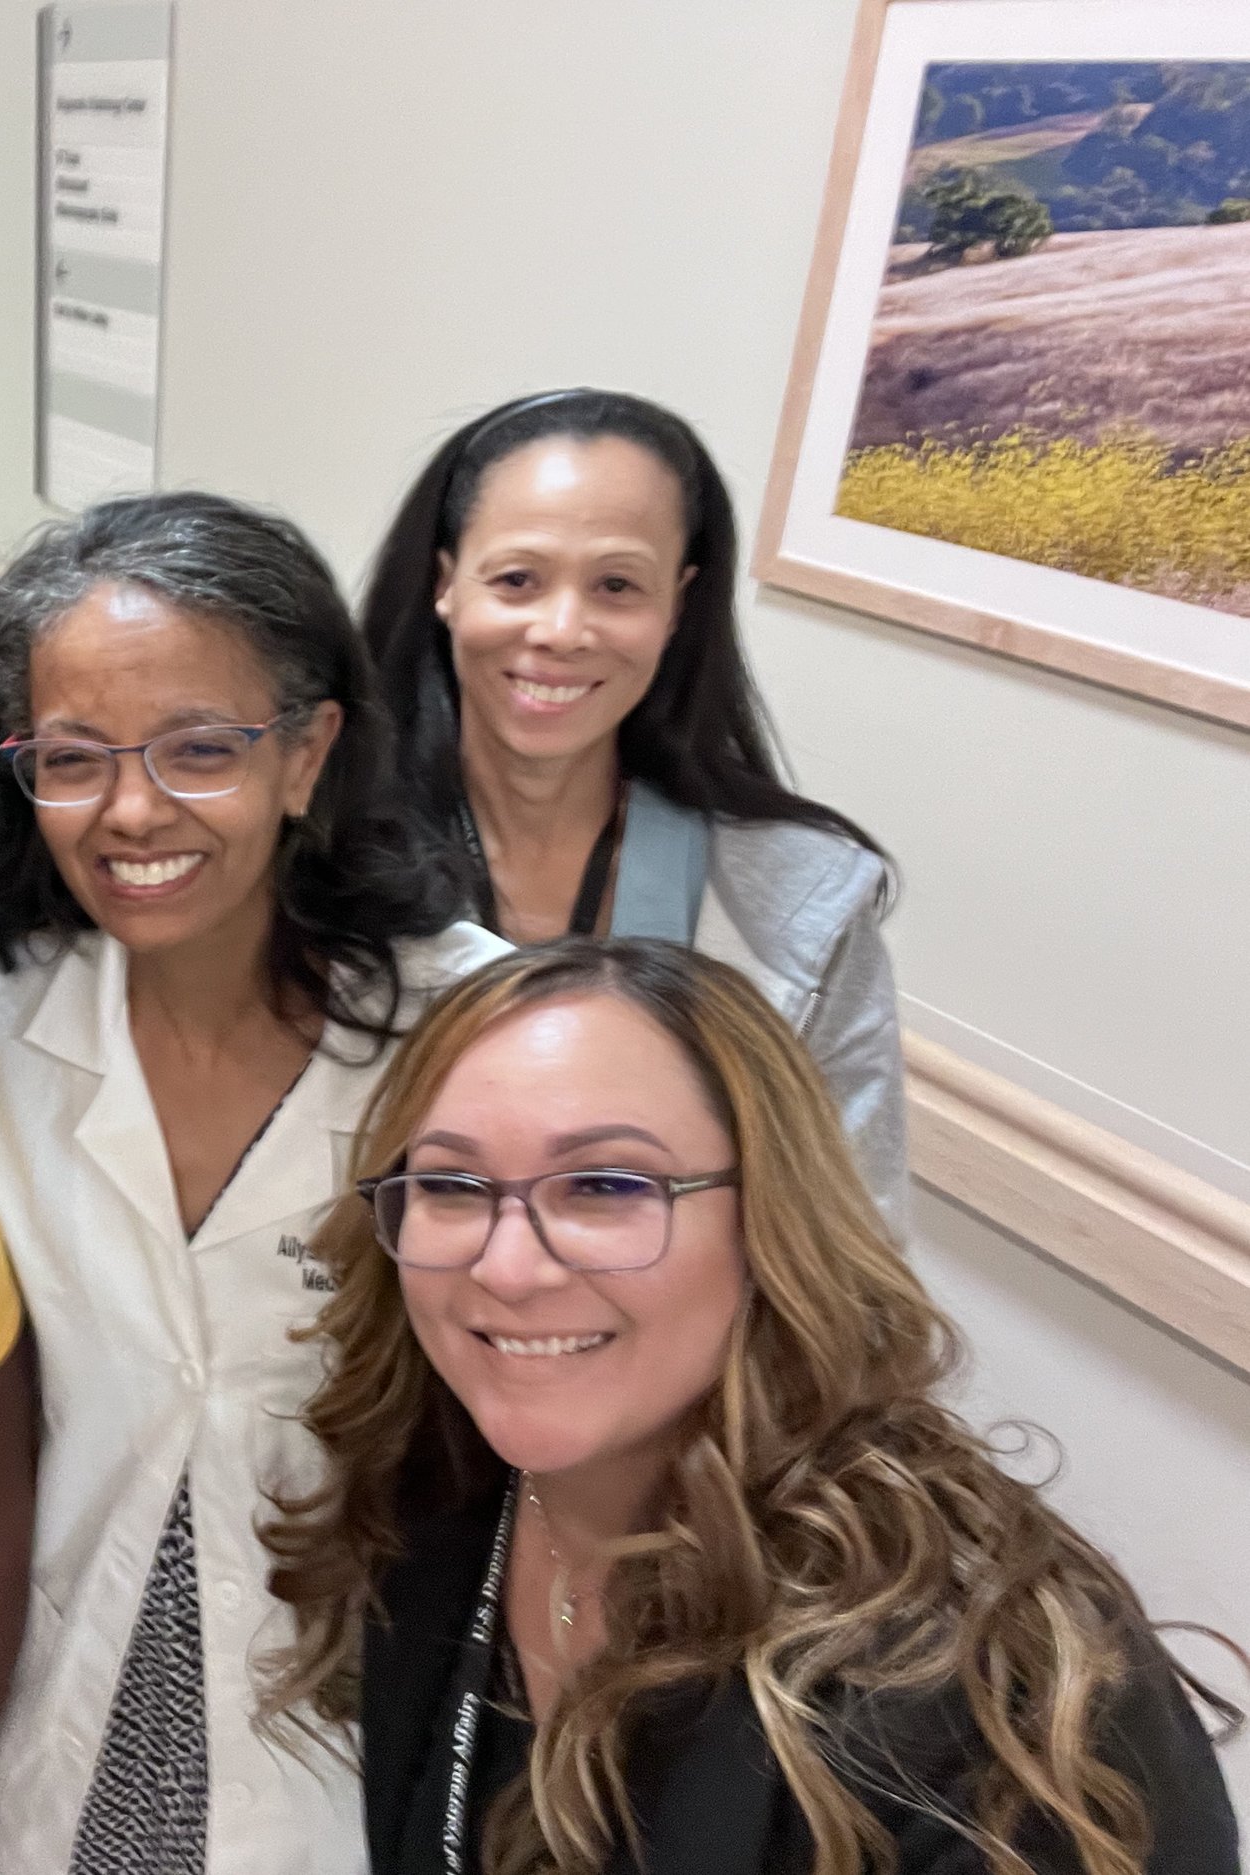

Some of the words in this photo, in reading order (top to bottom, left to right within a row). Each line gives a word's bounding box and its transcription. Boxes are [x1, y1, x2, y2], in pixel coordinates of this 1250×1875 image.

[471, 1603, 495, 1644] U.S.
[451, 1692, 480, 1766] Affairs
[443, 1761, 470, 1847] Veterans
[443, 1844, 462, 1873] of
